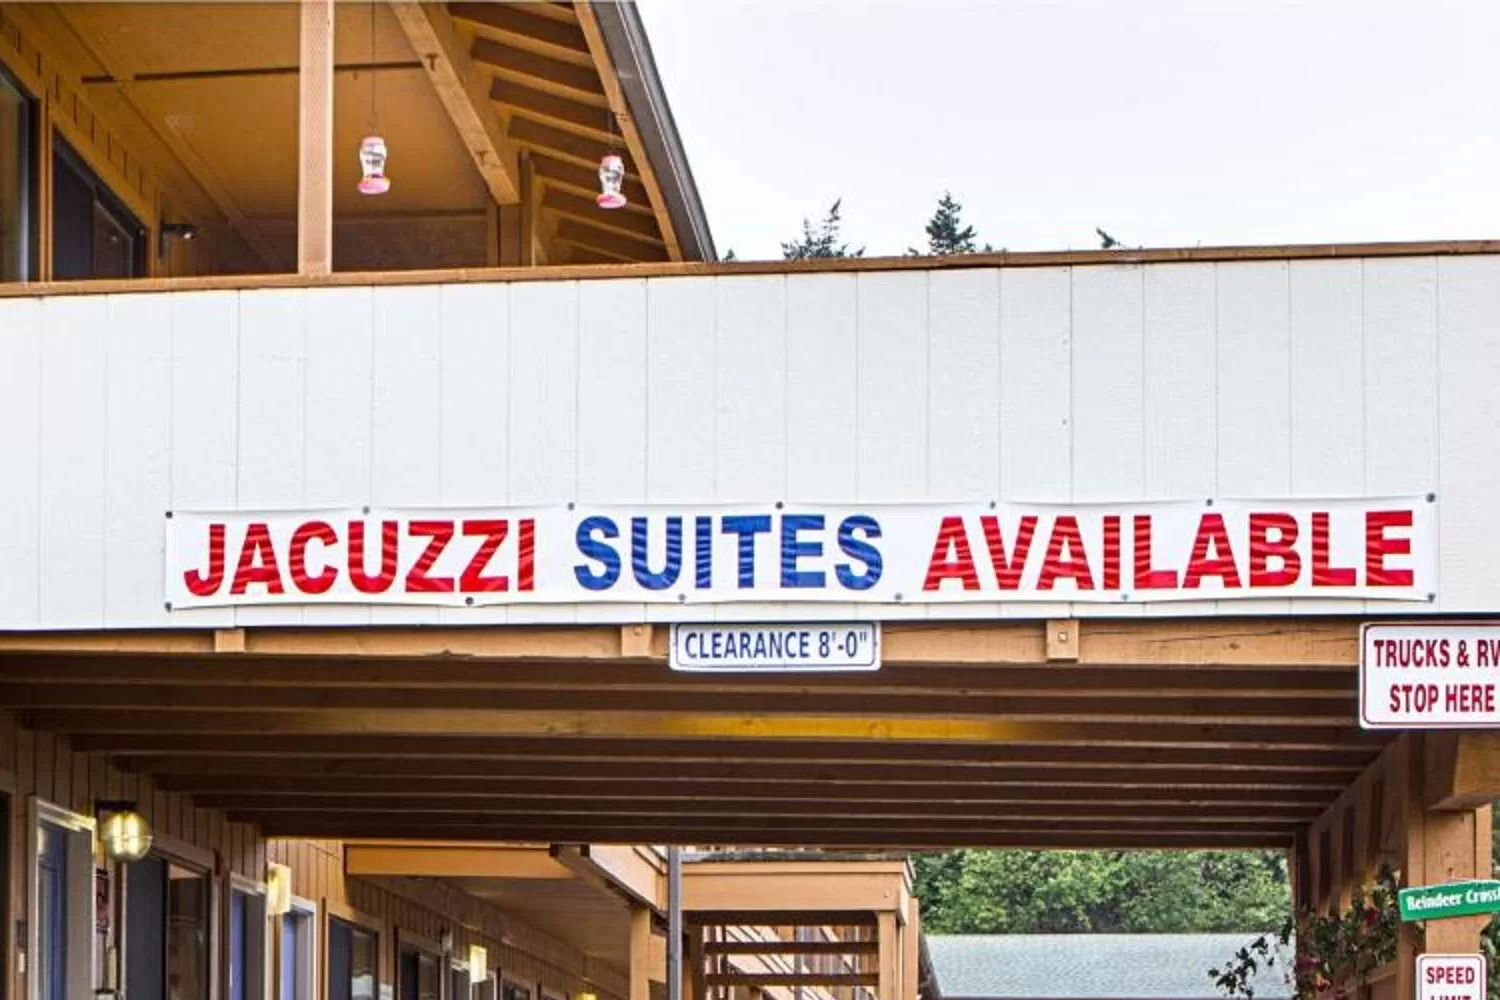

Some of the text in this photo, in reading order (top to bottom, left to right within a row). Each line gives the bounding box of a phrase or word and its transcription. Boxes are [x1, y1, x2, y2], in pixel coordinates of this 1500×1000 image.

[183, 509, 1414, 598] JACUZZI SUITES AVAILABLE
[685, 631, 810, 659] CLEARANCE
[1373, 639, 1451, 668] TRUCKS
[1457, 640, 1470, 668] &
[1389, 684, 1495, 713] STOP HERE
[1406, 892, 1463, 911] Reindeer
[1426, 966, 1475, 985] SPEED
